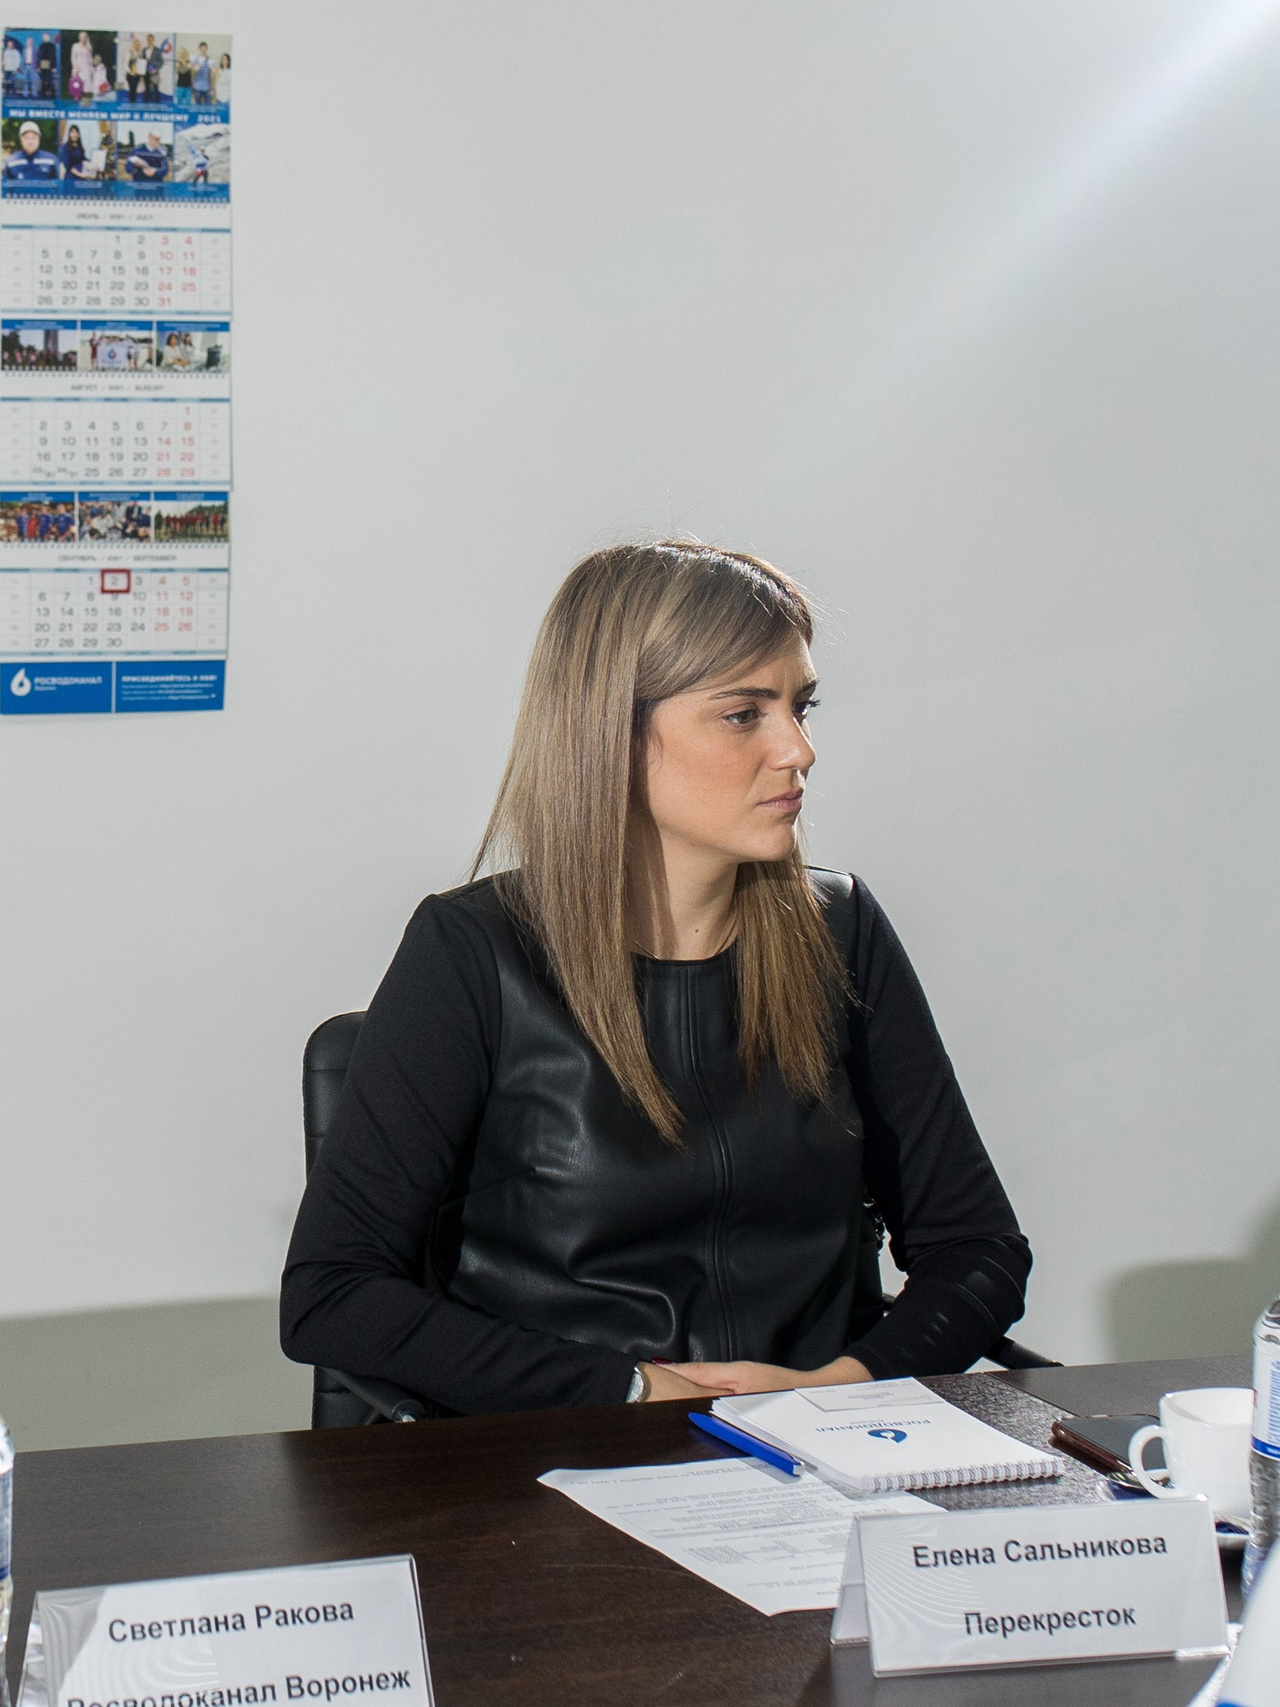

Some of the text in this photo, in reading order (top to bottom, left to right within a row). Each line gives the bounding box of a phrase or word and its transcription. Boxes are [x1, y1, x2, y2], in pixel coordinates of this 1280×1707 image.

[913, 1535, 1167, 1568] Елена Сальникова
[108, 1602, 354, 1643] Светлана Ракова
[964, 1606, 1137, 1639] Перекресток
[285, 1669, 411, 1701] Воронеж
